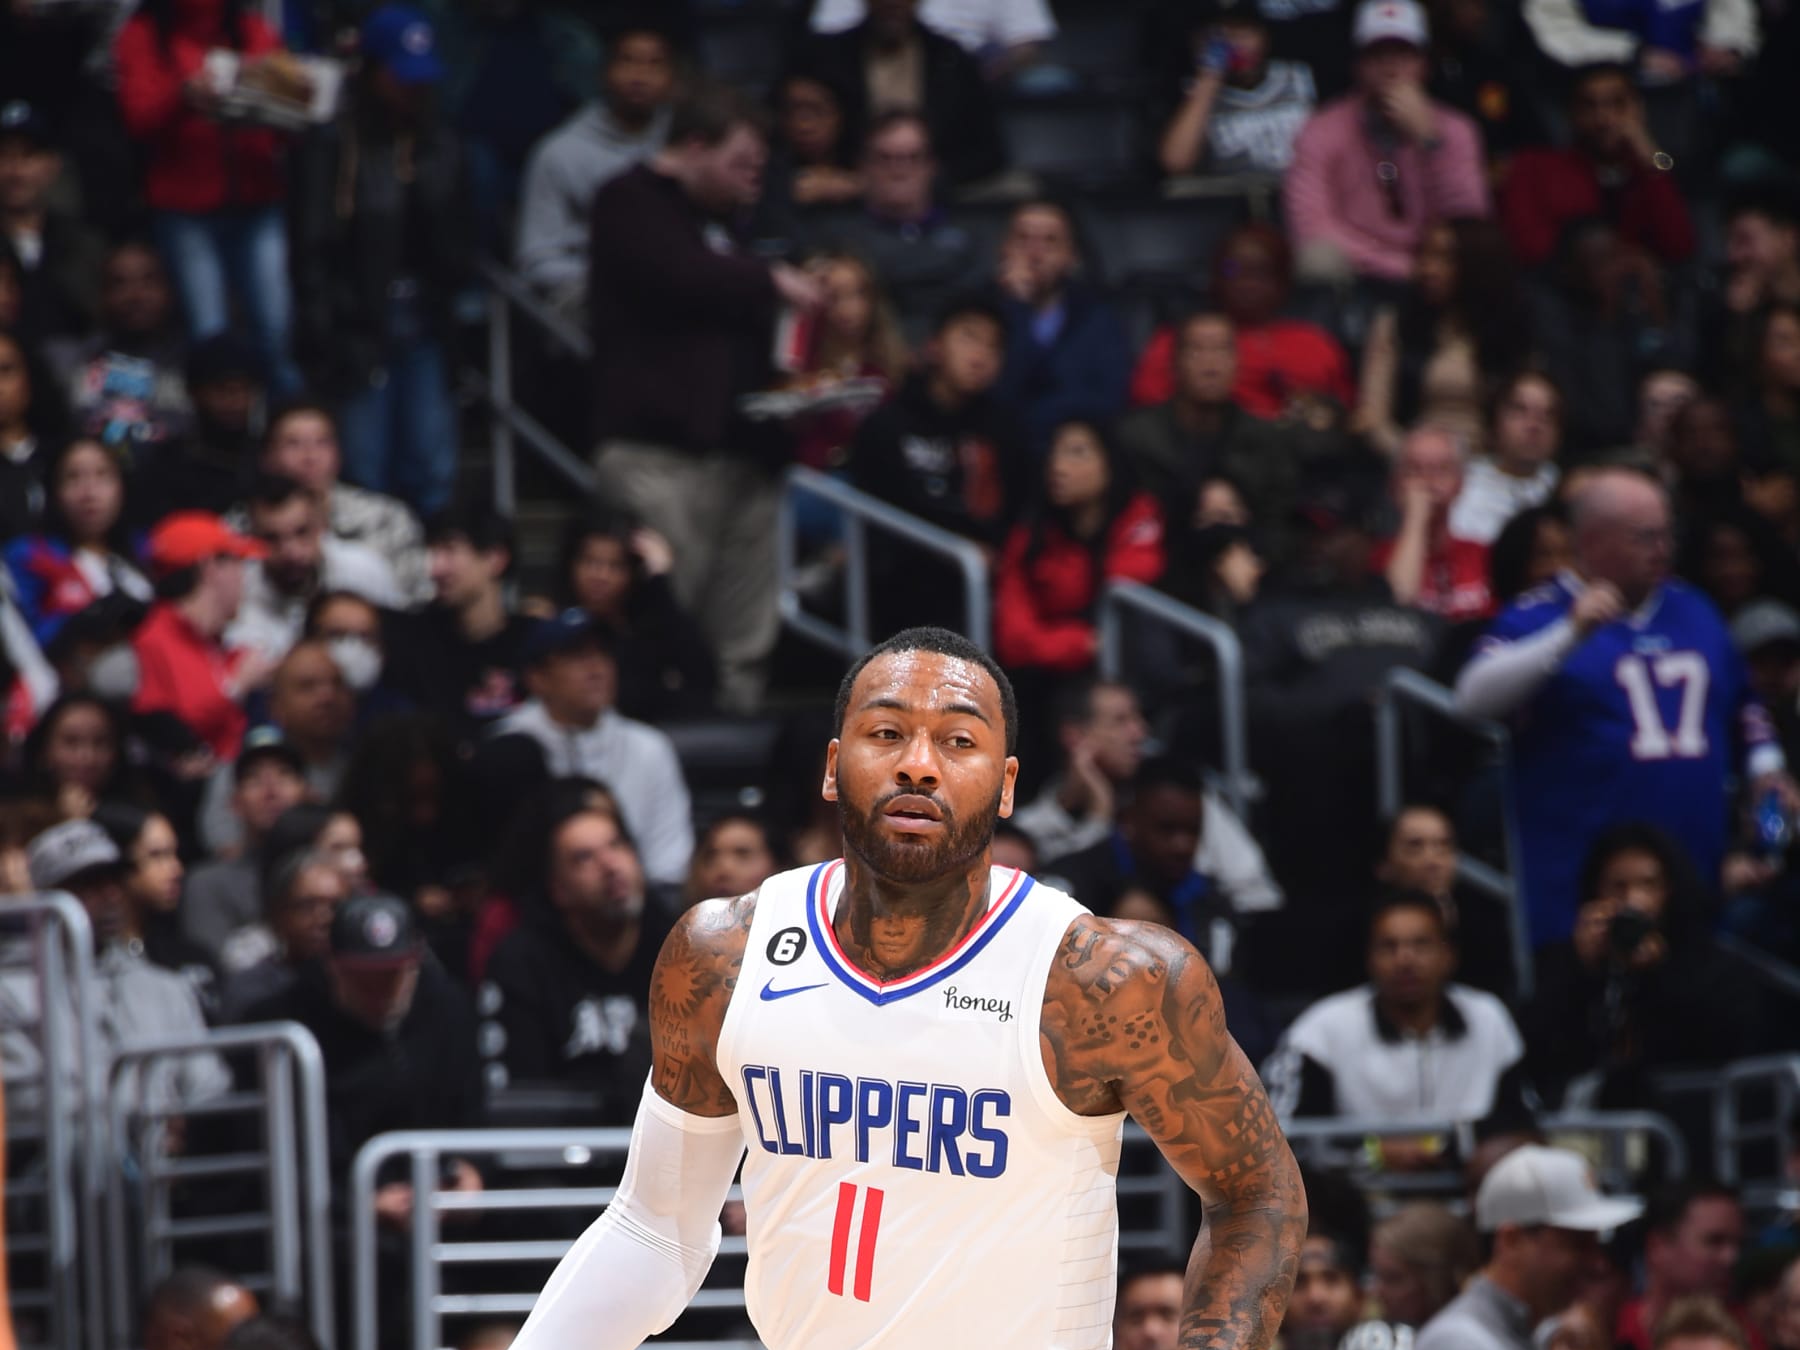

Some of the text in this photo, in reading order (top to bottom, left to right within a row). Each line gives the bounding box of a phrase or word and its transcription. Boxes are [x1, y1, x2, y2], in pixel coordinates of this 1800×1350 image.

[1615, 651, 1709, 759] 17
[773, 931, 800, 963] 6
[943, 985, 1013, 1023] honey
[741, 1063, 1012, 1179] CLIPPERS
[827, 1181, 884, 1303] 11
